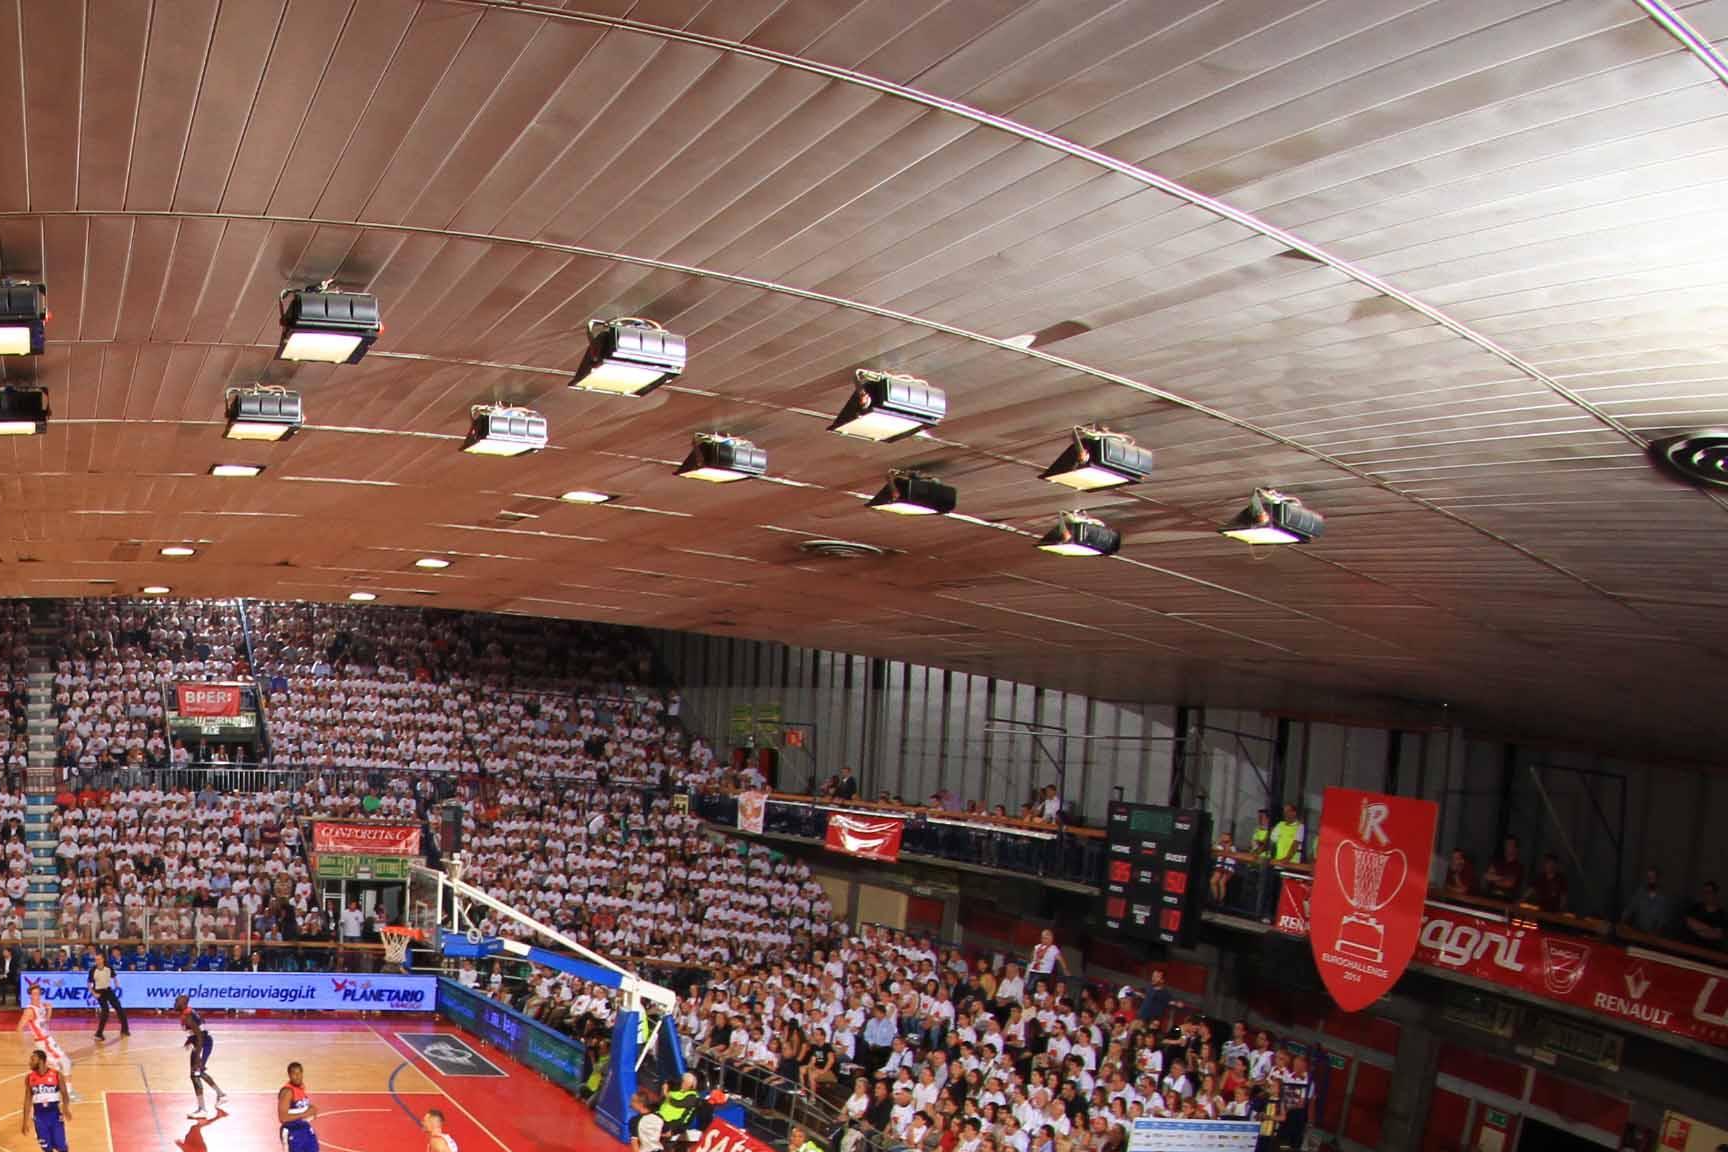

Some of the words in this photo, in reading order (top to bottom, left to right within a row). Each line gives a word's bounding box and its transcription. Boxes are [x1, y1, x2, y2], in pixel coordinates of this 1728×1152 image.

[146, 984, 316, 1002] wwwplanetarioviaggi.it
[342, 989, 424, 1002] PLANETARIO
[1594, 992, 1672, 1025] RENAULT
